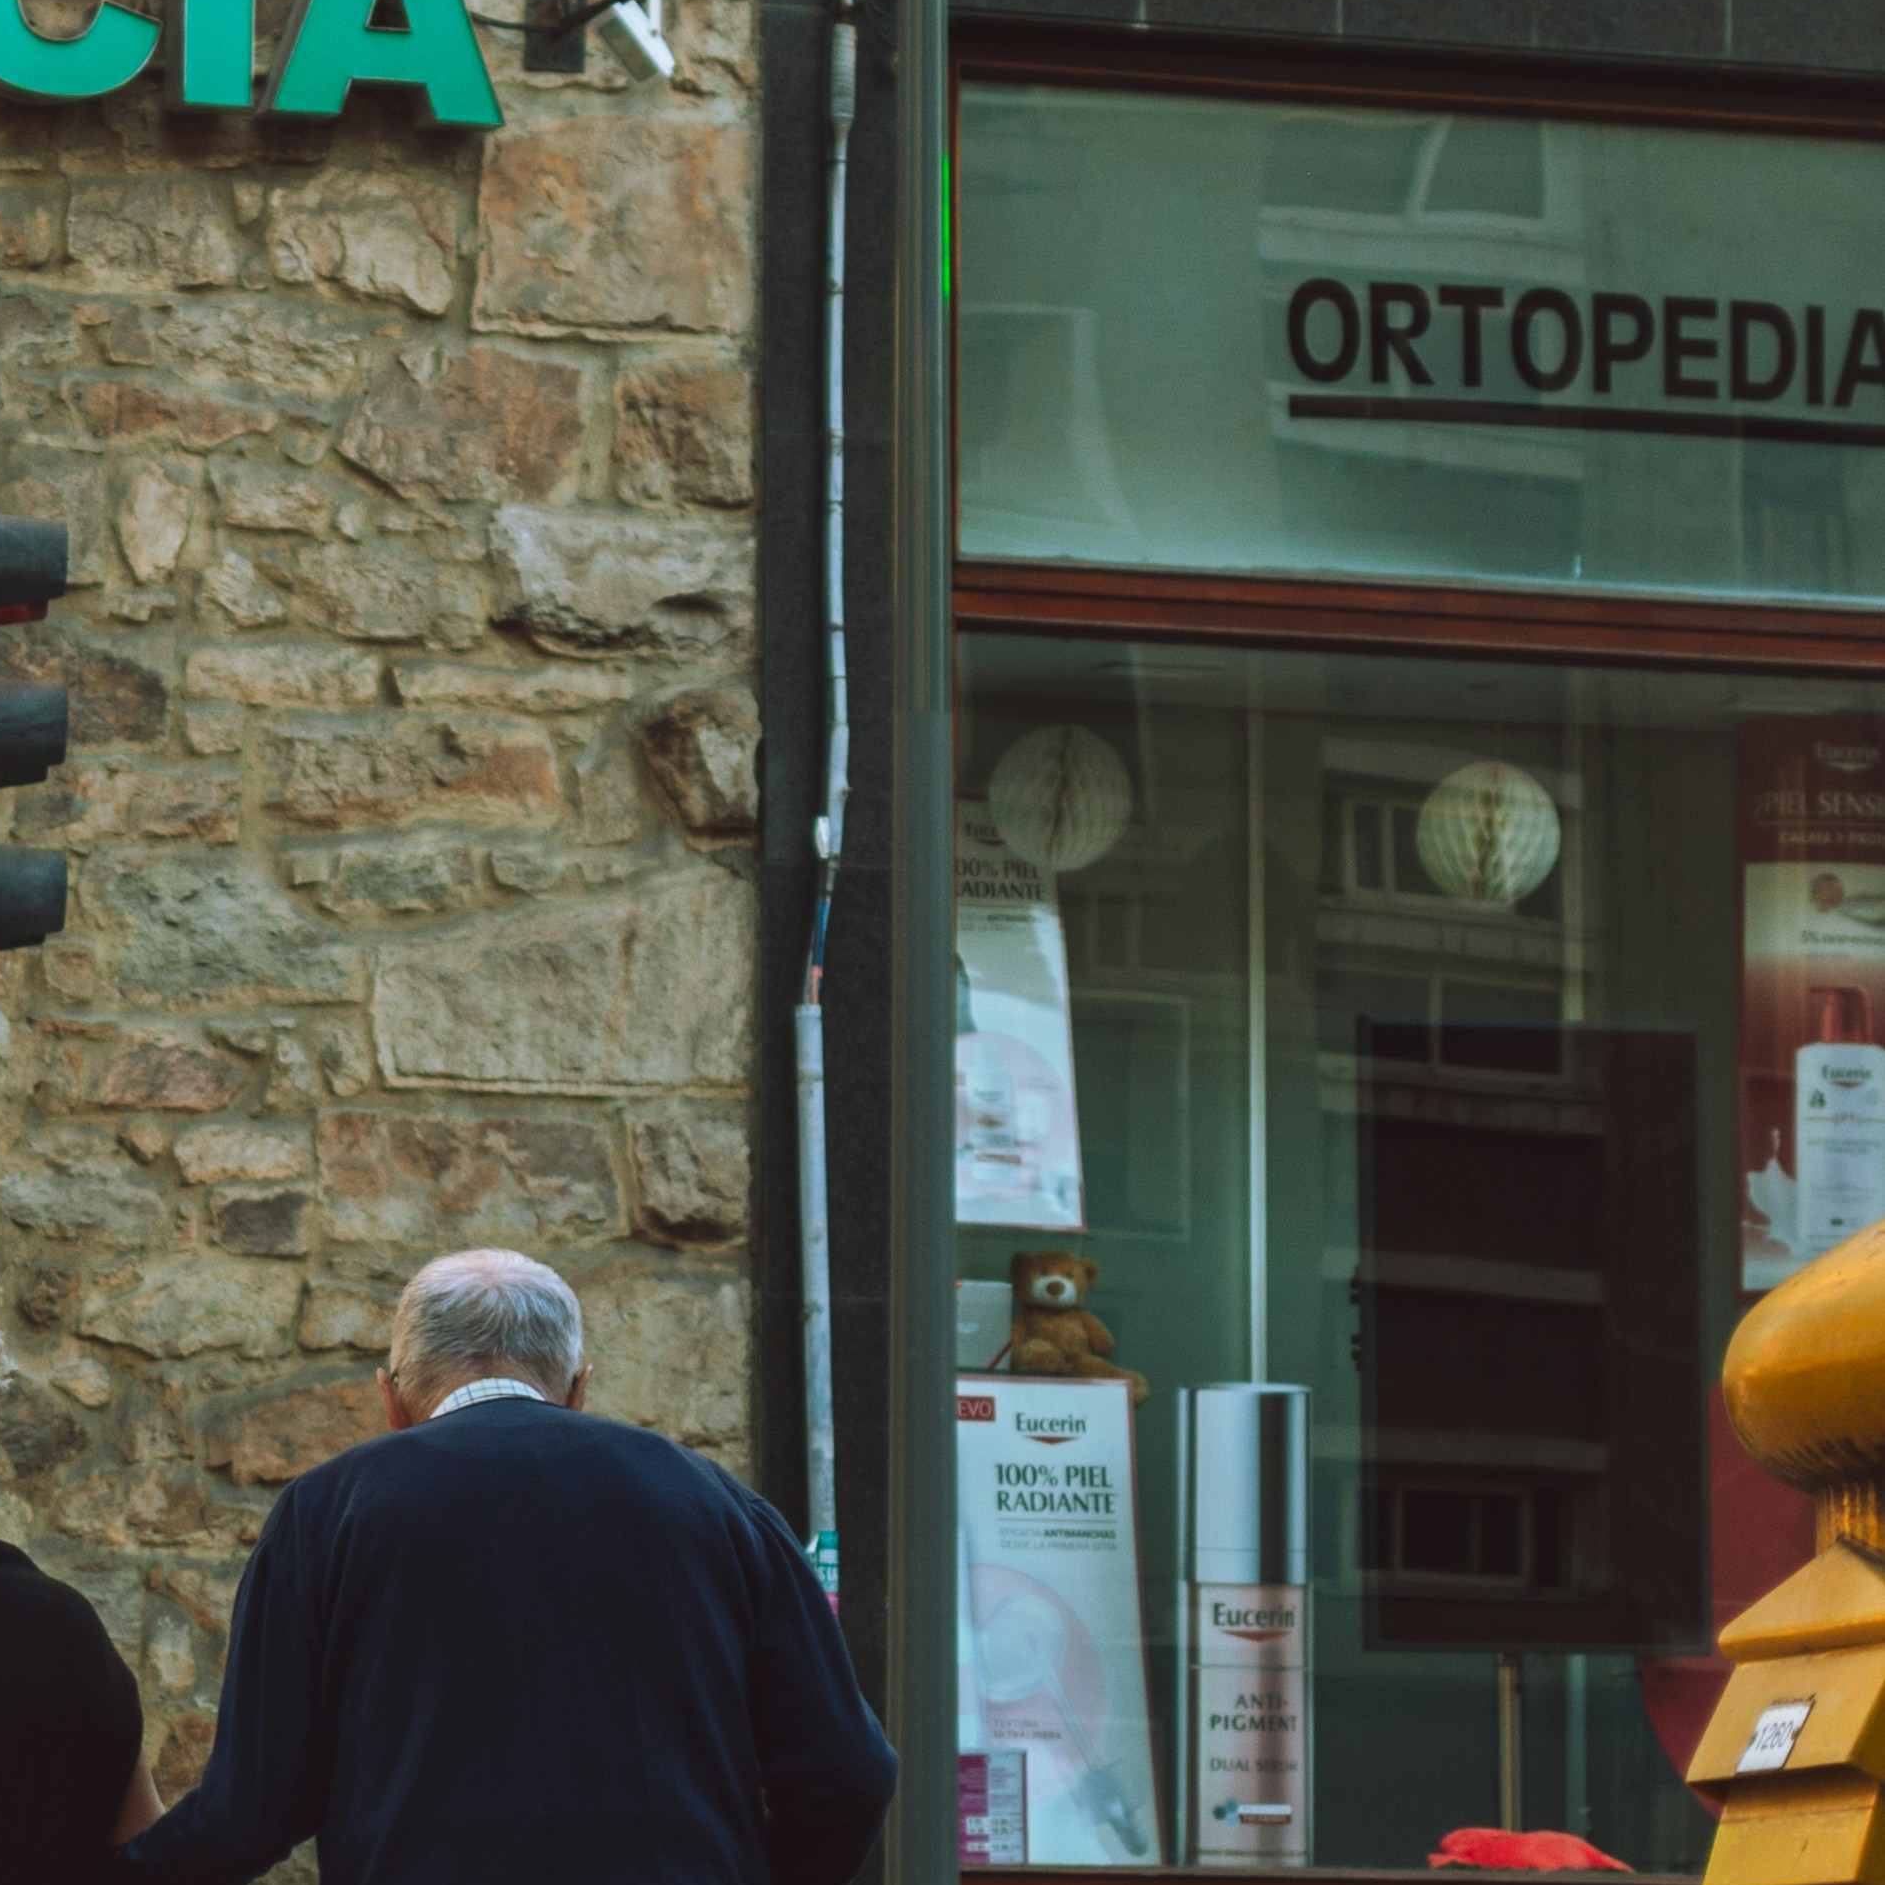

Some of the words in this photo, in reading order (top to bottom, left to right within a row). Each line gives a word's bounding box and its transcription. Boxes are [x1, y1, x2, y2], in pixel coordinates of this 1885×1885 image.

[1287, 277, 1885, 407] ORTOPEDIA
[960, 881, 1047, 901] ADIANTE
[957, 1399, 992, 1417] EVO
[1016, 1412, 1087, 1434] Eucerin
[995, 1463, 1058, 1487] 100%
[1065, 1465, 1113, 1489] PIEL
[996, 1491, 1117, 1514] RADIANTE
[1213, 1602, 1295, 1628] Eucerin
[1235, 1693, 1288, 1709] ANTI-
[1210, 1715, 1298, 1732] PIGMENT
[1755, 1721, 1794, 1751] 1260
[1210, 1758, 1250, 1771] DUAL
